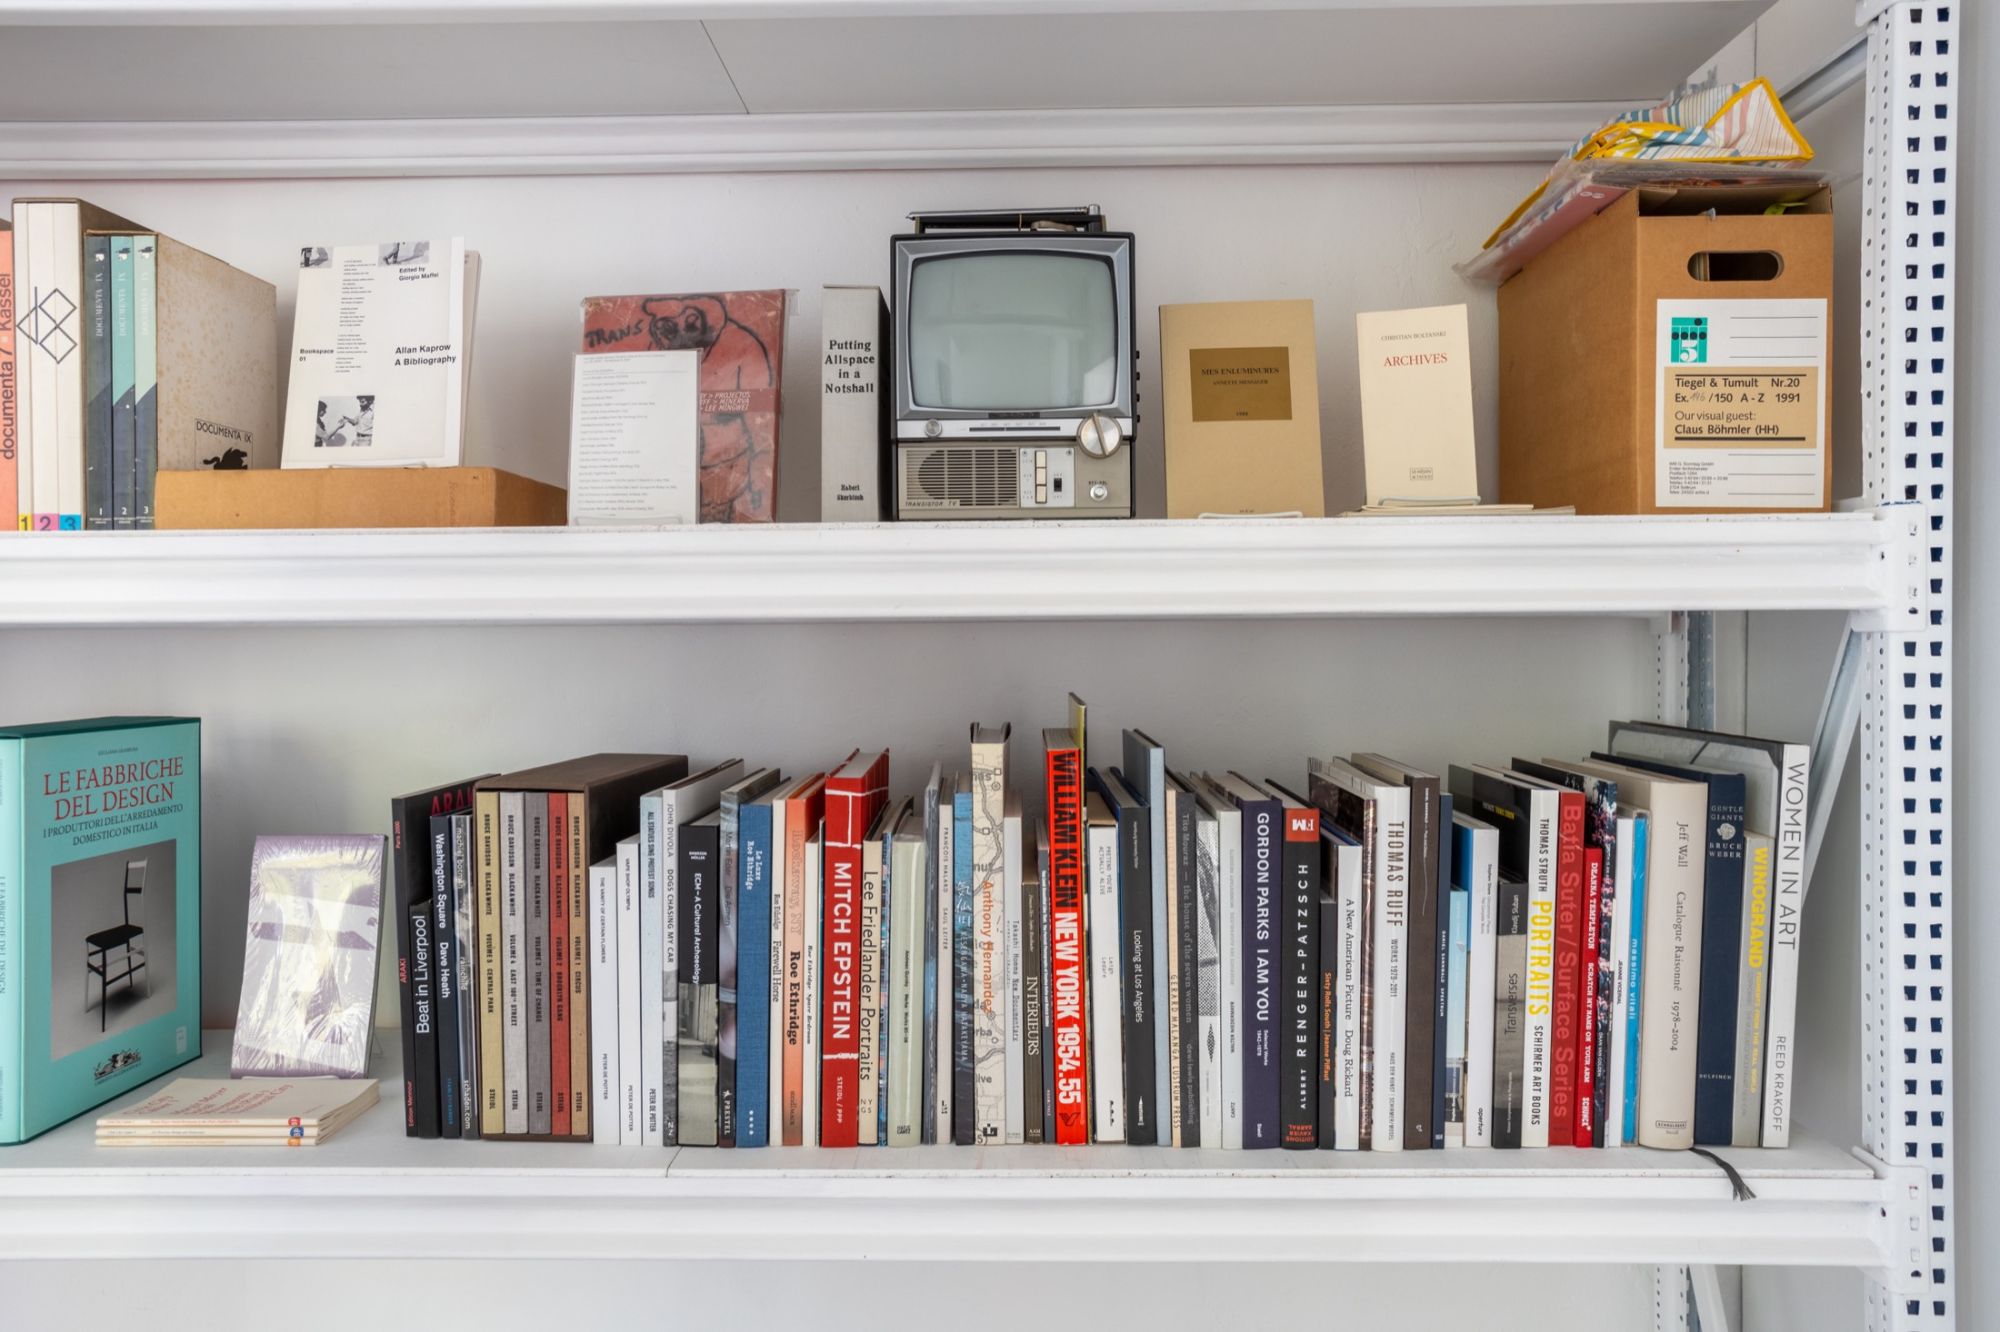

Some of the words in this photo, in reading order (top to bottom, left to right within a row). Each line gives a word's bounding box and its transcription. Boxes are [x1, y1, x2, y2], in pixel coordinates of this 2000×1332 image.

[0, 273, 12, 331] Kassel
[95, 289, 104, 337] DOCUMENTA
[395, 347, 417, 355] Allan
[419, 344, 451, 355] Kaprow
[585, 319, 645, 348] TRANS
[829, 340, 871, 352] Putting
[1381, 334, 1412, 342] CHRISTIAN
[394, 358, 401, 367] A
[404, 355, 456, 367] Bibliography
[825, 355, 875, 366] Allspace
[1384, 352, 1448, 367] ARCHIVES
[1680, 340, 1698, 362] 5
[838, 369, 849, 378] in
[1201, 367, 1219, 375] MES
[1221, 366, 1280, 375] ENLUMINURES
[1675, 378, 1705, 390] Tiegel
[1709, 378, 1718, 388] &
[1723, 377, 1758, 388] Tumult
[1771, 378, 1800, 388] Nr.20
[825, 383, 874, 393] Notshall
[1675, 393, 1689, 403] Ex.
[1776, 393, 1801, 403] 1991
[0, 361, 15, 460] documenta
[1675, 411, 1694, 421] Our
[1696, 410, 1724, 421] visual
[1726, 411, 1756, 424] guest:
[196, 420, 241, 441] DOCUMENTA
[244, 432, 252, 443] IX
[1675, 425, 1703, 435] Claus
[1708, 424, 1750, 435] Böhmler
[1755, 424, 1779, 436] (HH)
[44, 772, 70, 796] LE
[76, 756, 184, 791] FABBRICHE
[55, 794, 97, 820] DEL
[103, 782, 174, 812] DESIGN
[1053, 752, 1077, 843] WILLIAM
[1783, 763, 1805, 860] WOMEN
[47, 818, 103, 837] PRODUTTORI
[72, 830, 122, 846] DOMESTICO
[123, 827, 131, 835] IN
[132, 820, 158, 834] ITALIA
[1539, 818, 1549, 855] THOMAS
[1676, 821, 1688, 842] Jeff
[435, 833, 445, 892] Washington
[755, 850, 763, 860] Le
[1257, 812, 1269, 883] GORDON
[1387, 821, 1405, 882] THOMAS
[1677, 844, 1688, 868] Wall
[694, 872, 702, 890] ECM
[755, 861, 763, 880] Luxe
[863, 871, 878, 900] Lee
[1054, 848, 1078, 908] KLEIN
[1538, 857, 1548, 892] STRUTH
[1590, 862, 1598, 896] DEANNA
[1781, 871, 1799, 894] IN
[437, 894, 447, 929] Square
[833, 862, 851, 934] MITCH
[980, 880, 994, 937] Anthony
[1257, 887, 1269, 940] PARKS
[1386, 890, 1403, 927] RUFF
[1560, 872, 1578, 934] Suter
[1748, 847, 1769, 968] WINOGRAND
[693, 904, 701, 935] Cultural
[1346, 910, 1354, 930] New
[1588, 898, 1597, 949] TEMPLETON
[1673, 891, 1686, 941] Catalogue
[1778, 904, 1796, 950] ART
[413, 915, 429, 980] Liverpool
[667, 931, 674, 944] MY
[1012, 920, 1020, 949] Takashi
[1055, 912, 1079, 962] NEW
[1132, 930, 1143, 962] Looking
[1390, 939, 1398, 963] WORKS
[440, 942, 449, 966] Dave
[773, 940, 782, 975] Farewell
[790, 951, 800, 978] Roe
[861, 906, 877, 1002] Friedlander
[1134, 964, 1142, 973] at
[1257, 957, 1268, 984] AM
[1345, 932, 1354, 980] American
[1529, 901, 1552, 1015] PORTRAITS
[1630, 939, 1638, 988] massimo
[1673, 945, 1684, 991] Raisonné
[415, 984, 428, 996] in
[440, 969, 450, 998] Heath
[772, 977, 782, 1002] Horse
[833, 942, 851, 1039] EPSTEIN
[983, 941, 994, 1014] Hernandez
[1056, 965, 1080, 1019] YORK
[1134, 974, 1143, 988] Los
[1133, 990, 1144, 1023] Angeles
[1256, 987, 1268, 1021] YOU
[1345, 984, 1354, 1020] Picture
[1504, 973, 1518, 1035] Transverses
[1556, 951, 1577, 1039] Surface
[1629, 992, 1638, 1020] vitali
[416, 1000, 430, 1033] Beat
[787, 982, 800, 1045] Ethridge
[1026, 976, 1040, 1056] INTÉRIEURS
[860, 1008, 876, 1081] Portraits
[1343, 1030, 1353, 1056] Doug
[1532, 1025, 1543, 1072] SCHIRMER
[1775, 1036, 1787, 1069] REED
[1056, 1023, 1081, 1104] 1954.55
[1344, 1059, 1353, 1097] Rickard
[1172, 1065, 1180, 1101] LUSTRUM
[1532, 1075, 1542, 1092] ART
[1553, 1047, 1574, 1118] Series
[1531, 1096, 1541, 1125] BOOKS
[1772, 1073, 1785, 1132] KRAKOFF
